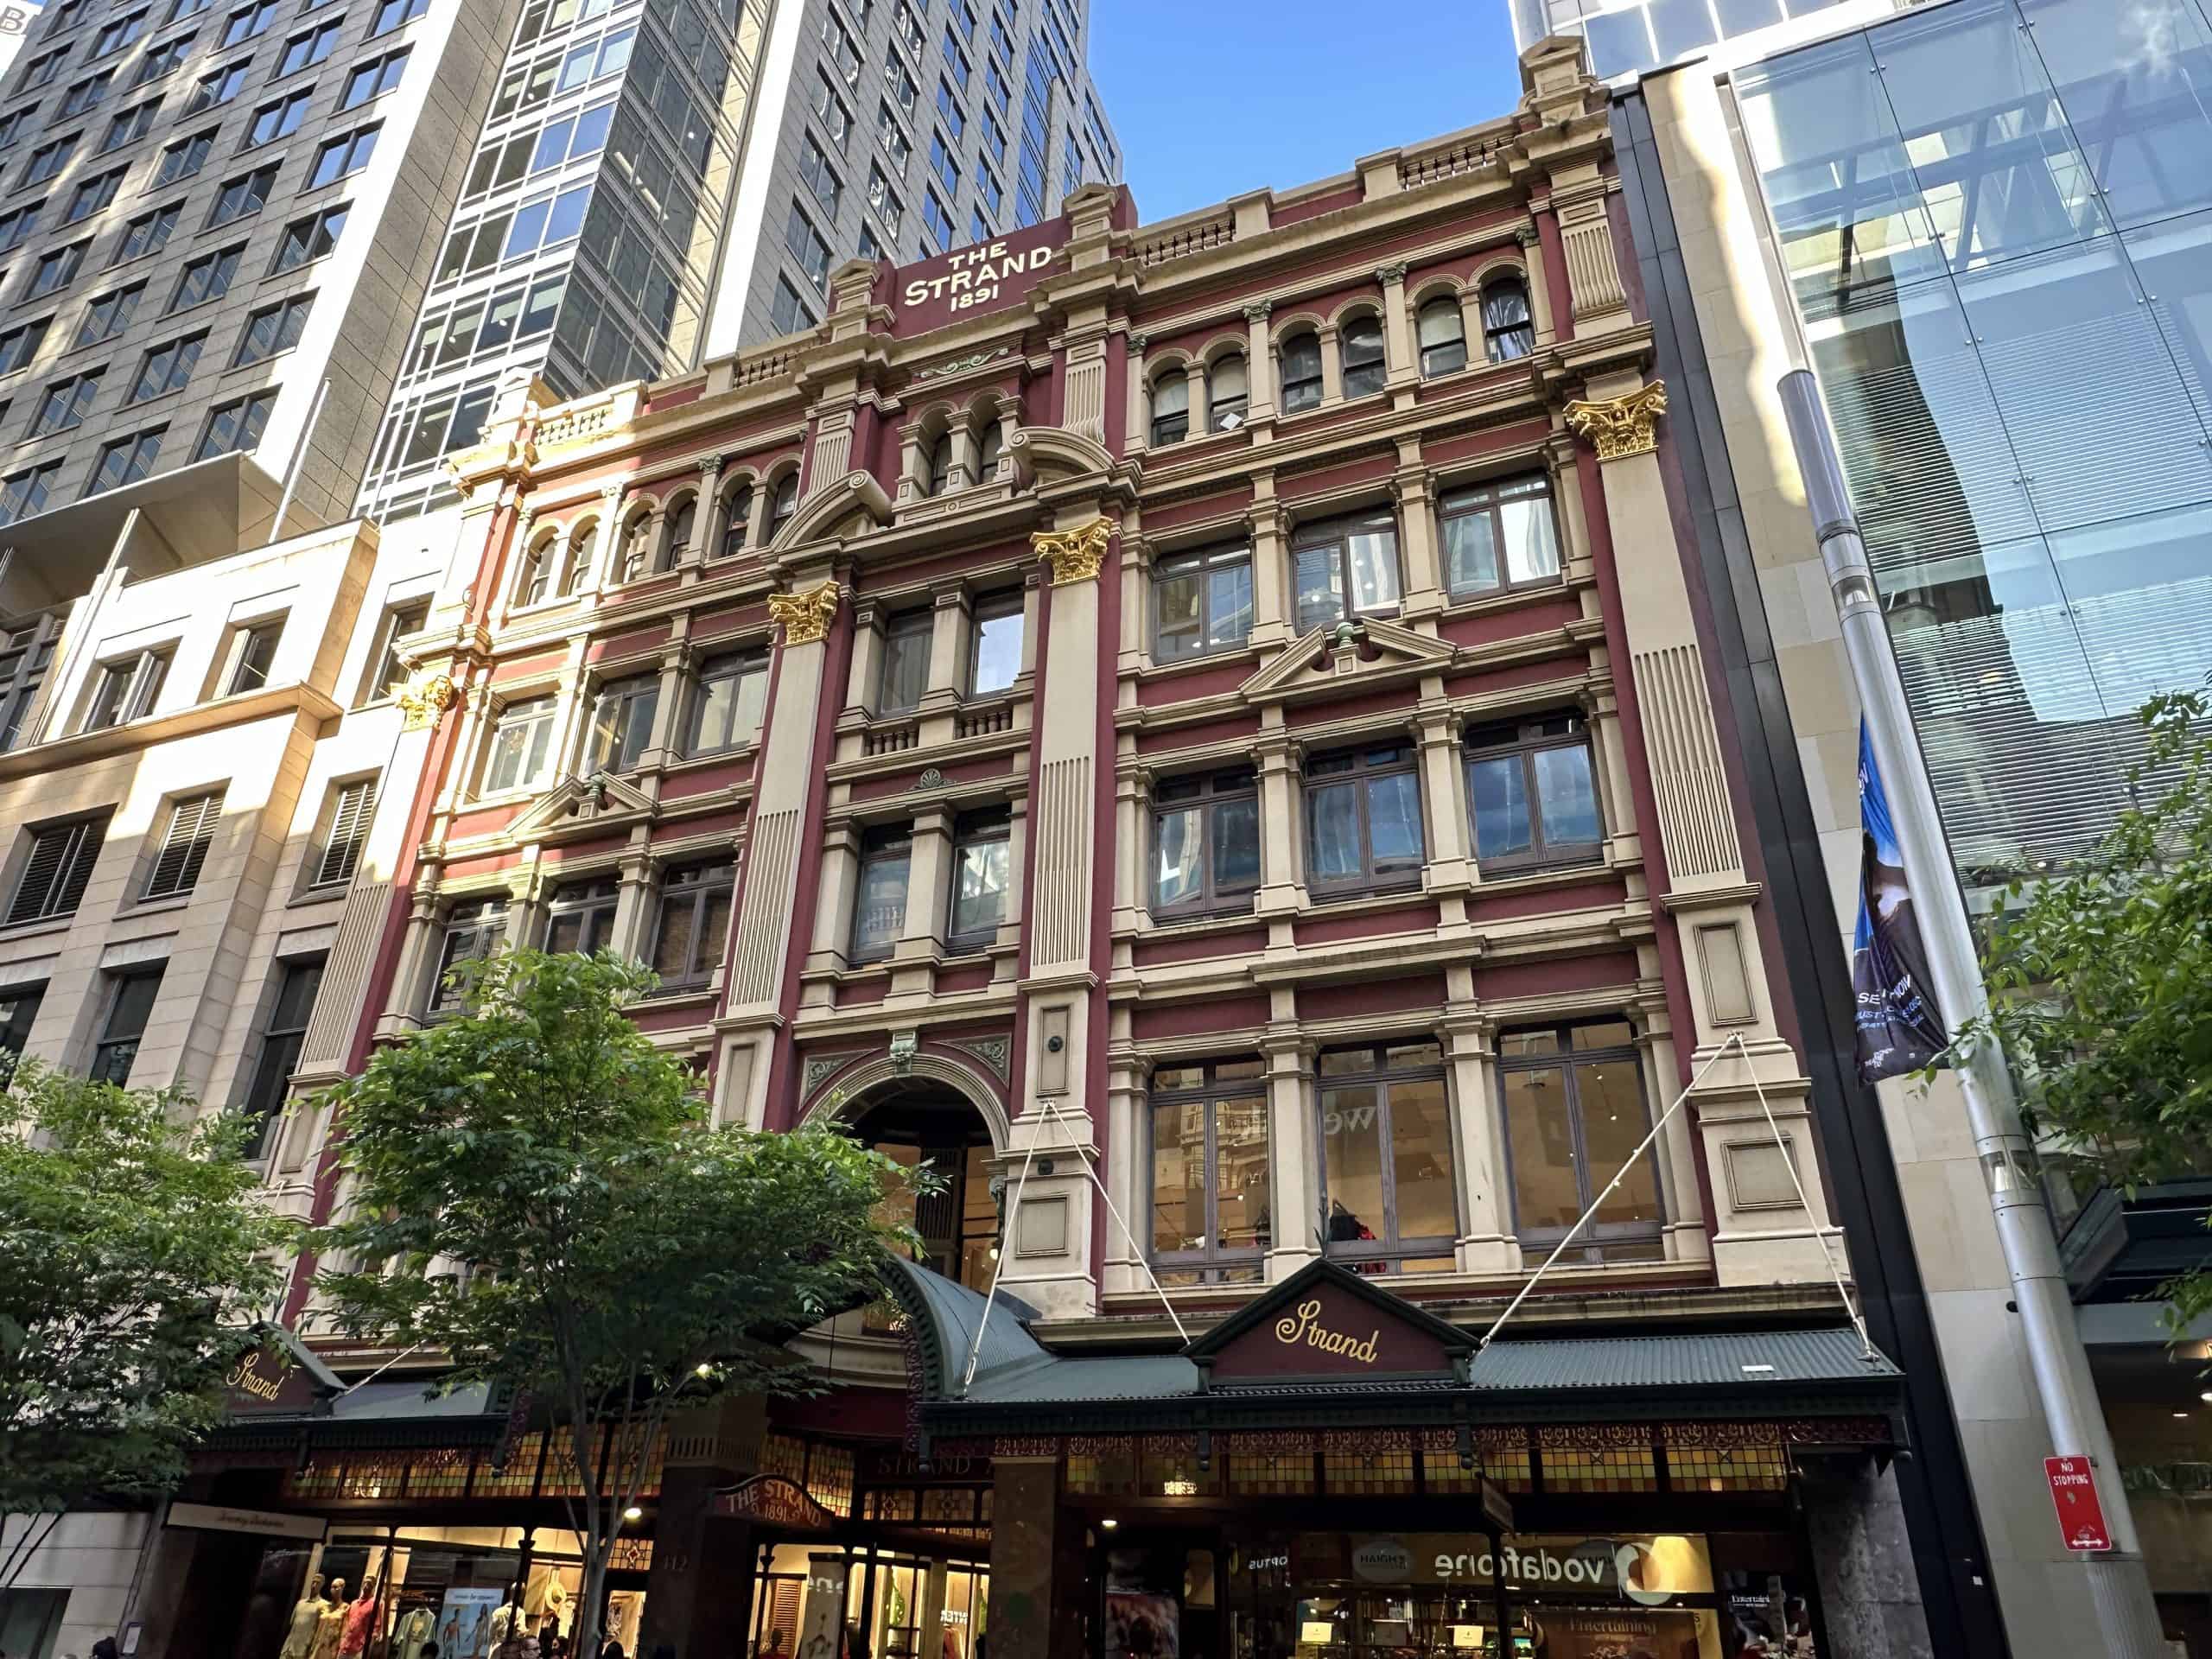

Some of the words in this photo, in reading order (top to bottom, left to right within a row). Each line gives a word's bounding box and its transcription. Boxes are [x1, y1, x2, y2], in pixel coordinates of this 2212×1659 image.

[949, 241, 1007, 270] THE
[904, 246, 1052, 306] STRAND
[950, 283, 999, 312] 1891
[1275, 1300, 1379, 1363] Strand
[226, 1352, 285, 1401] Strand
[2053, 1473, 2088, 1486] STOPPING
[2061, 1462, 2074, 1472] NO
[726, 1484, 760, 1513] THE
[765, 1479, 822, 1527] STRAND
[764, 1503, 787, 1522] 1891
